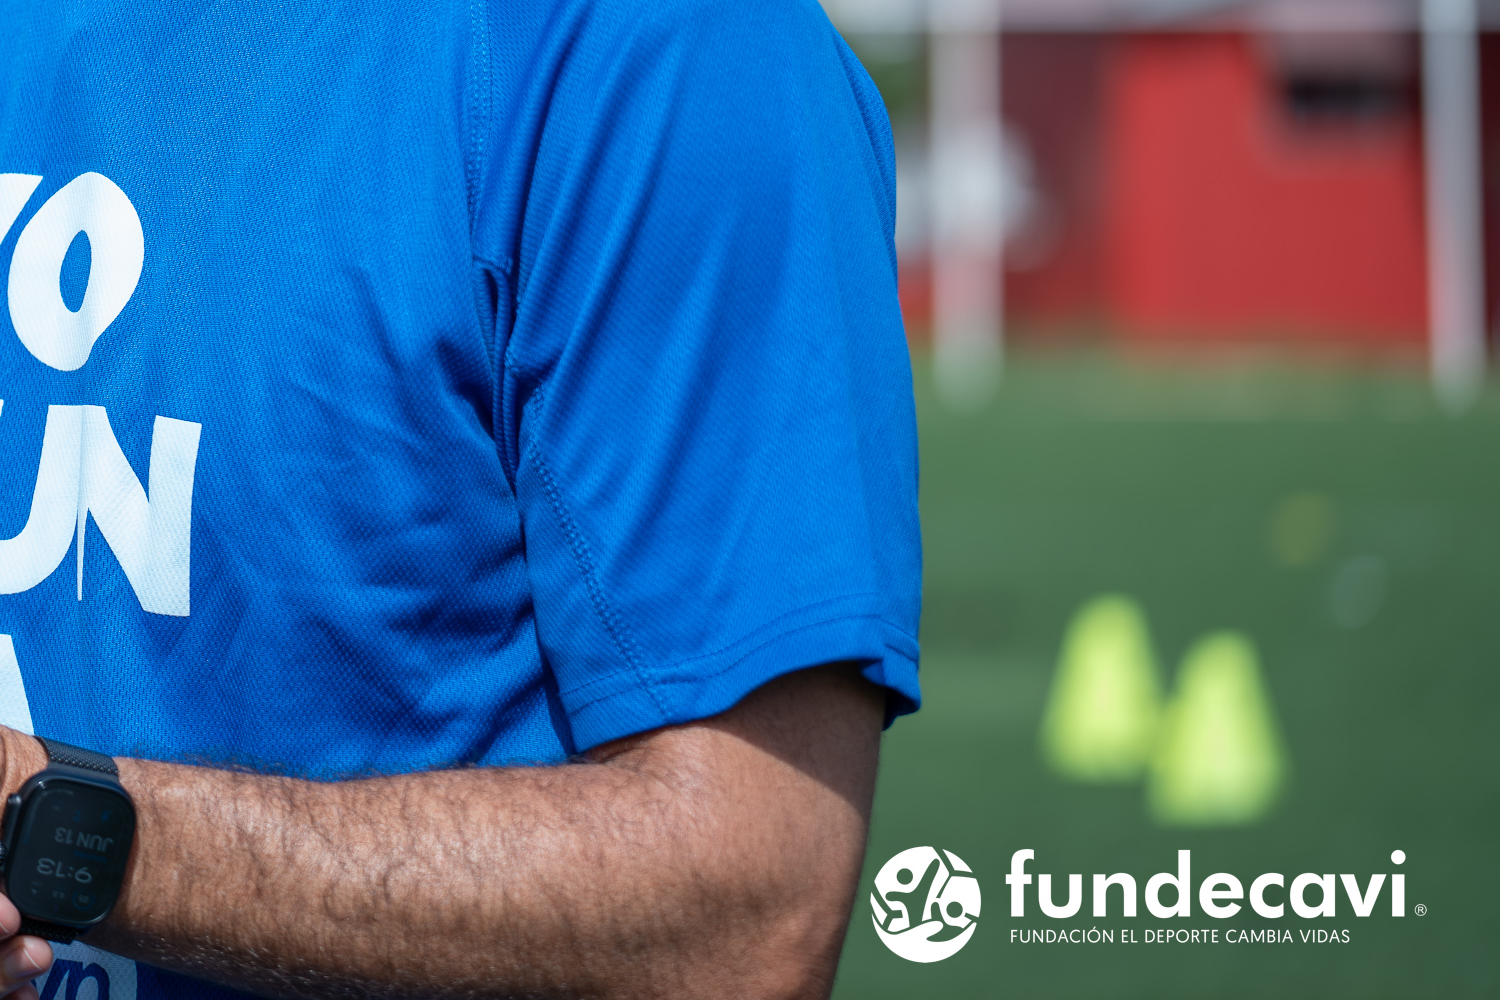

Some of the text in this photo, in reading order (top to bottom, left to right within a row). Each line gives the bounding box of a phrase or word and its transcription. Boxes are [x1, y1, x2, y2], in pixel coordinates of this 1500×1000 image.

[54, 826, 115, 852] JUN 13
[36, 857, 93, 884] 9:13
